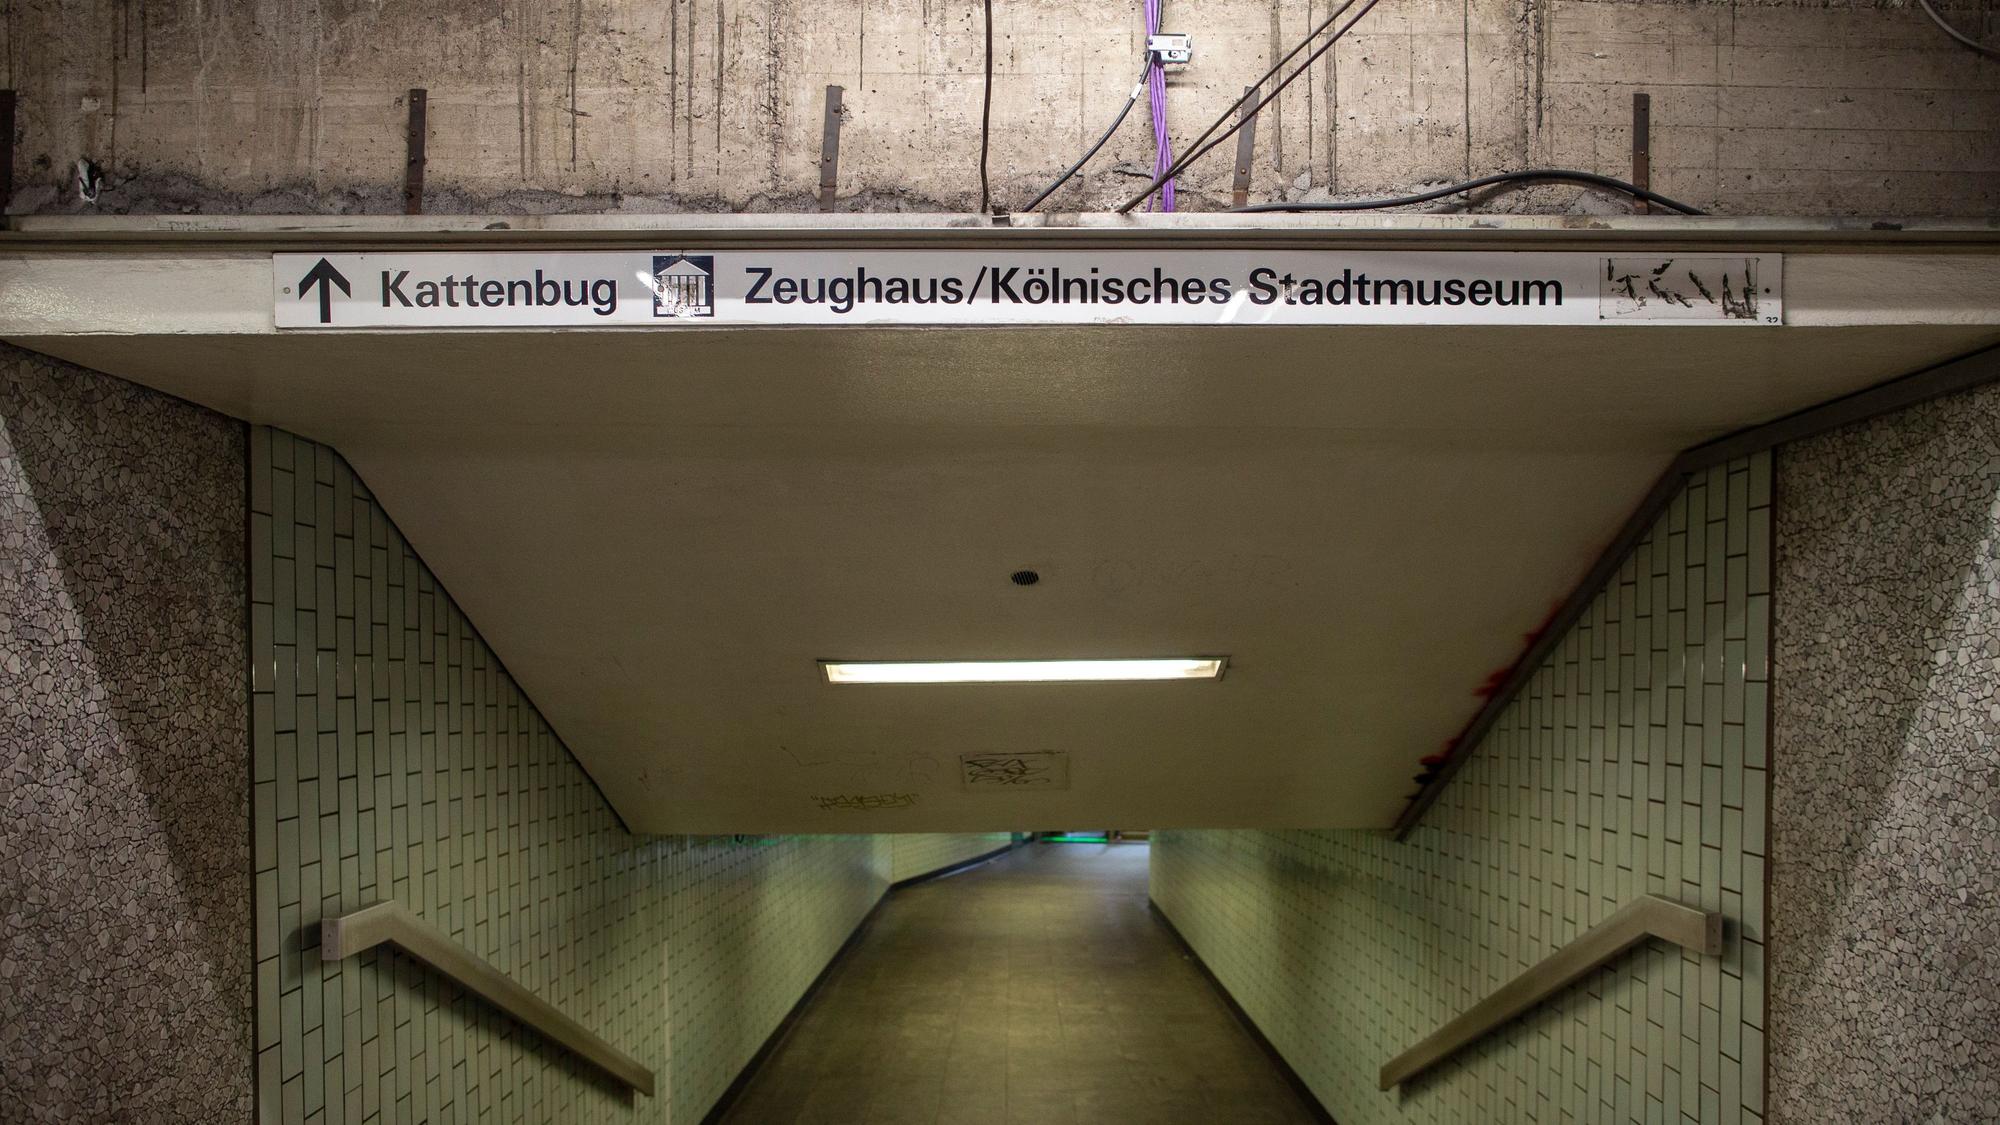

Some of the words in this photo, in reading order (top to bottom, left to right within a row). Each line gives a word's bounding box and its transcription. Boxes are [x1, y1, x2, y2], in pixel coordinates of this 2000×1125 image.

[381, 270, 618, 316] Kattenbug
[745, 265, 1232, 314] Zeughaus/Kölnisches
[1249, 267, 1563, 306] Stadtmuseum
